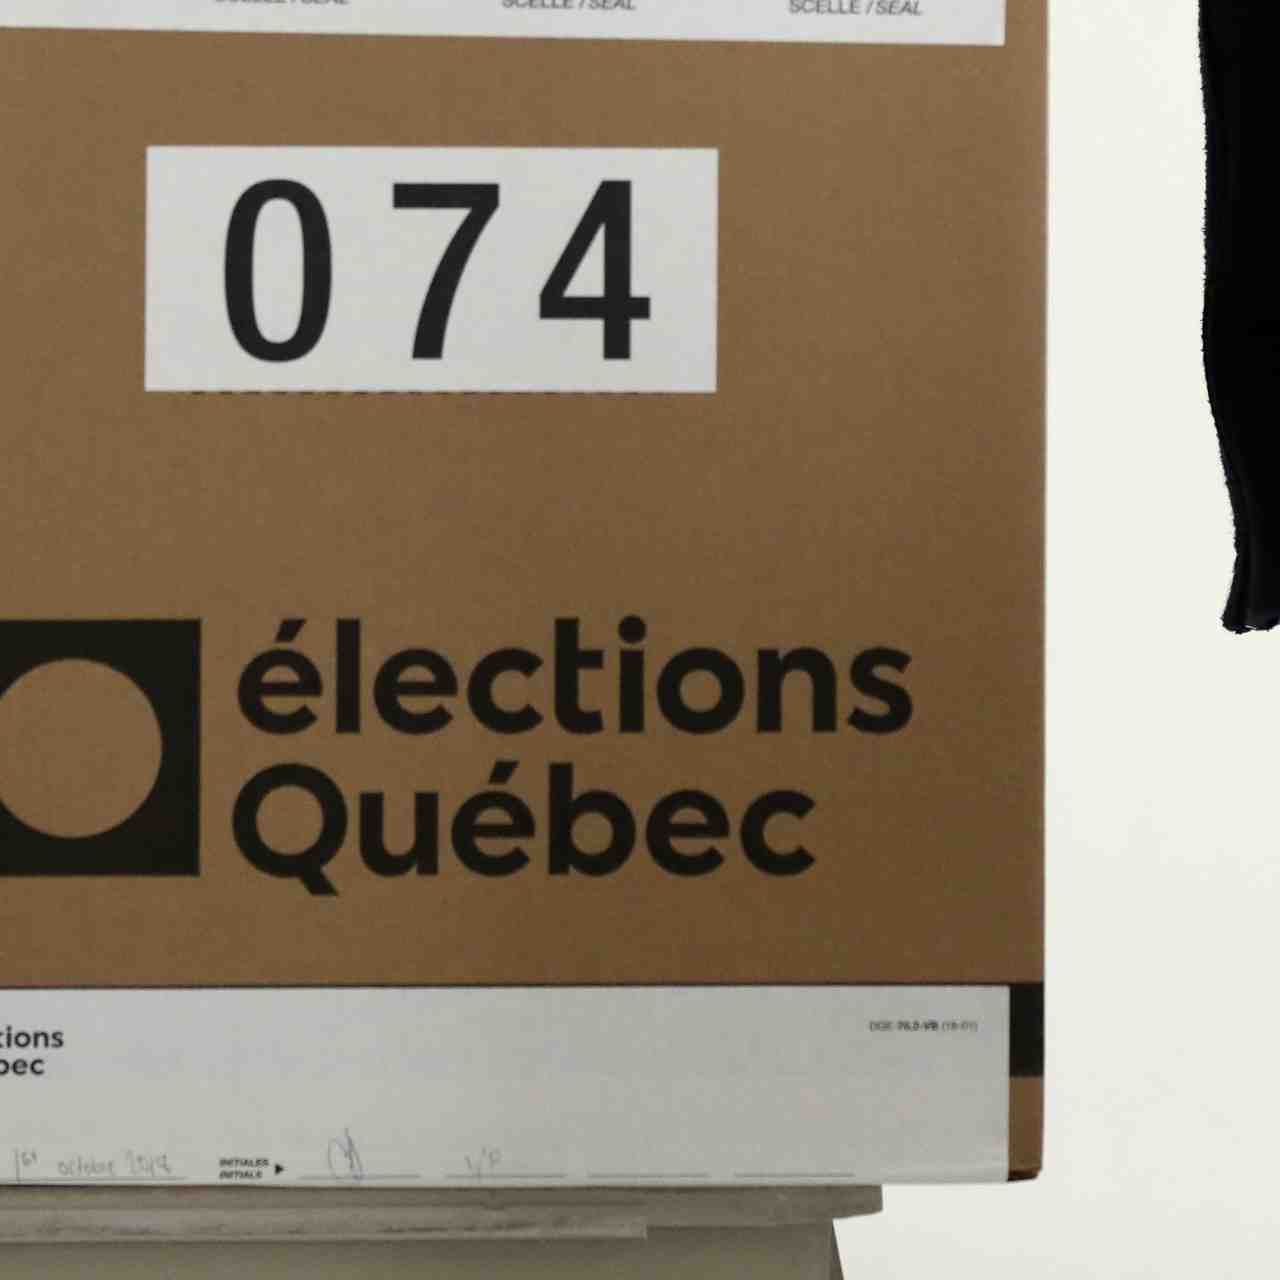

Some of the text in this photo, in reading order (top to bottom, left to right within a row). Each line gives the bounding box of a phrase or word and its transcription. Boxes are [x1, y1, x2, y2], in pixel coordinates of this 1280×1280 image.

[224, 178, 652, 363] 074
[236, 614, 915, 735] élections
[231, 760, 817, 897] Québec
